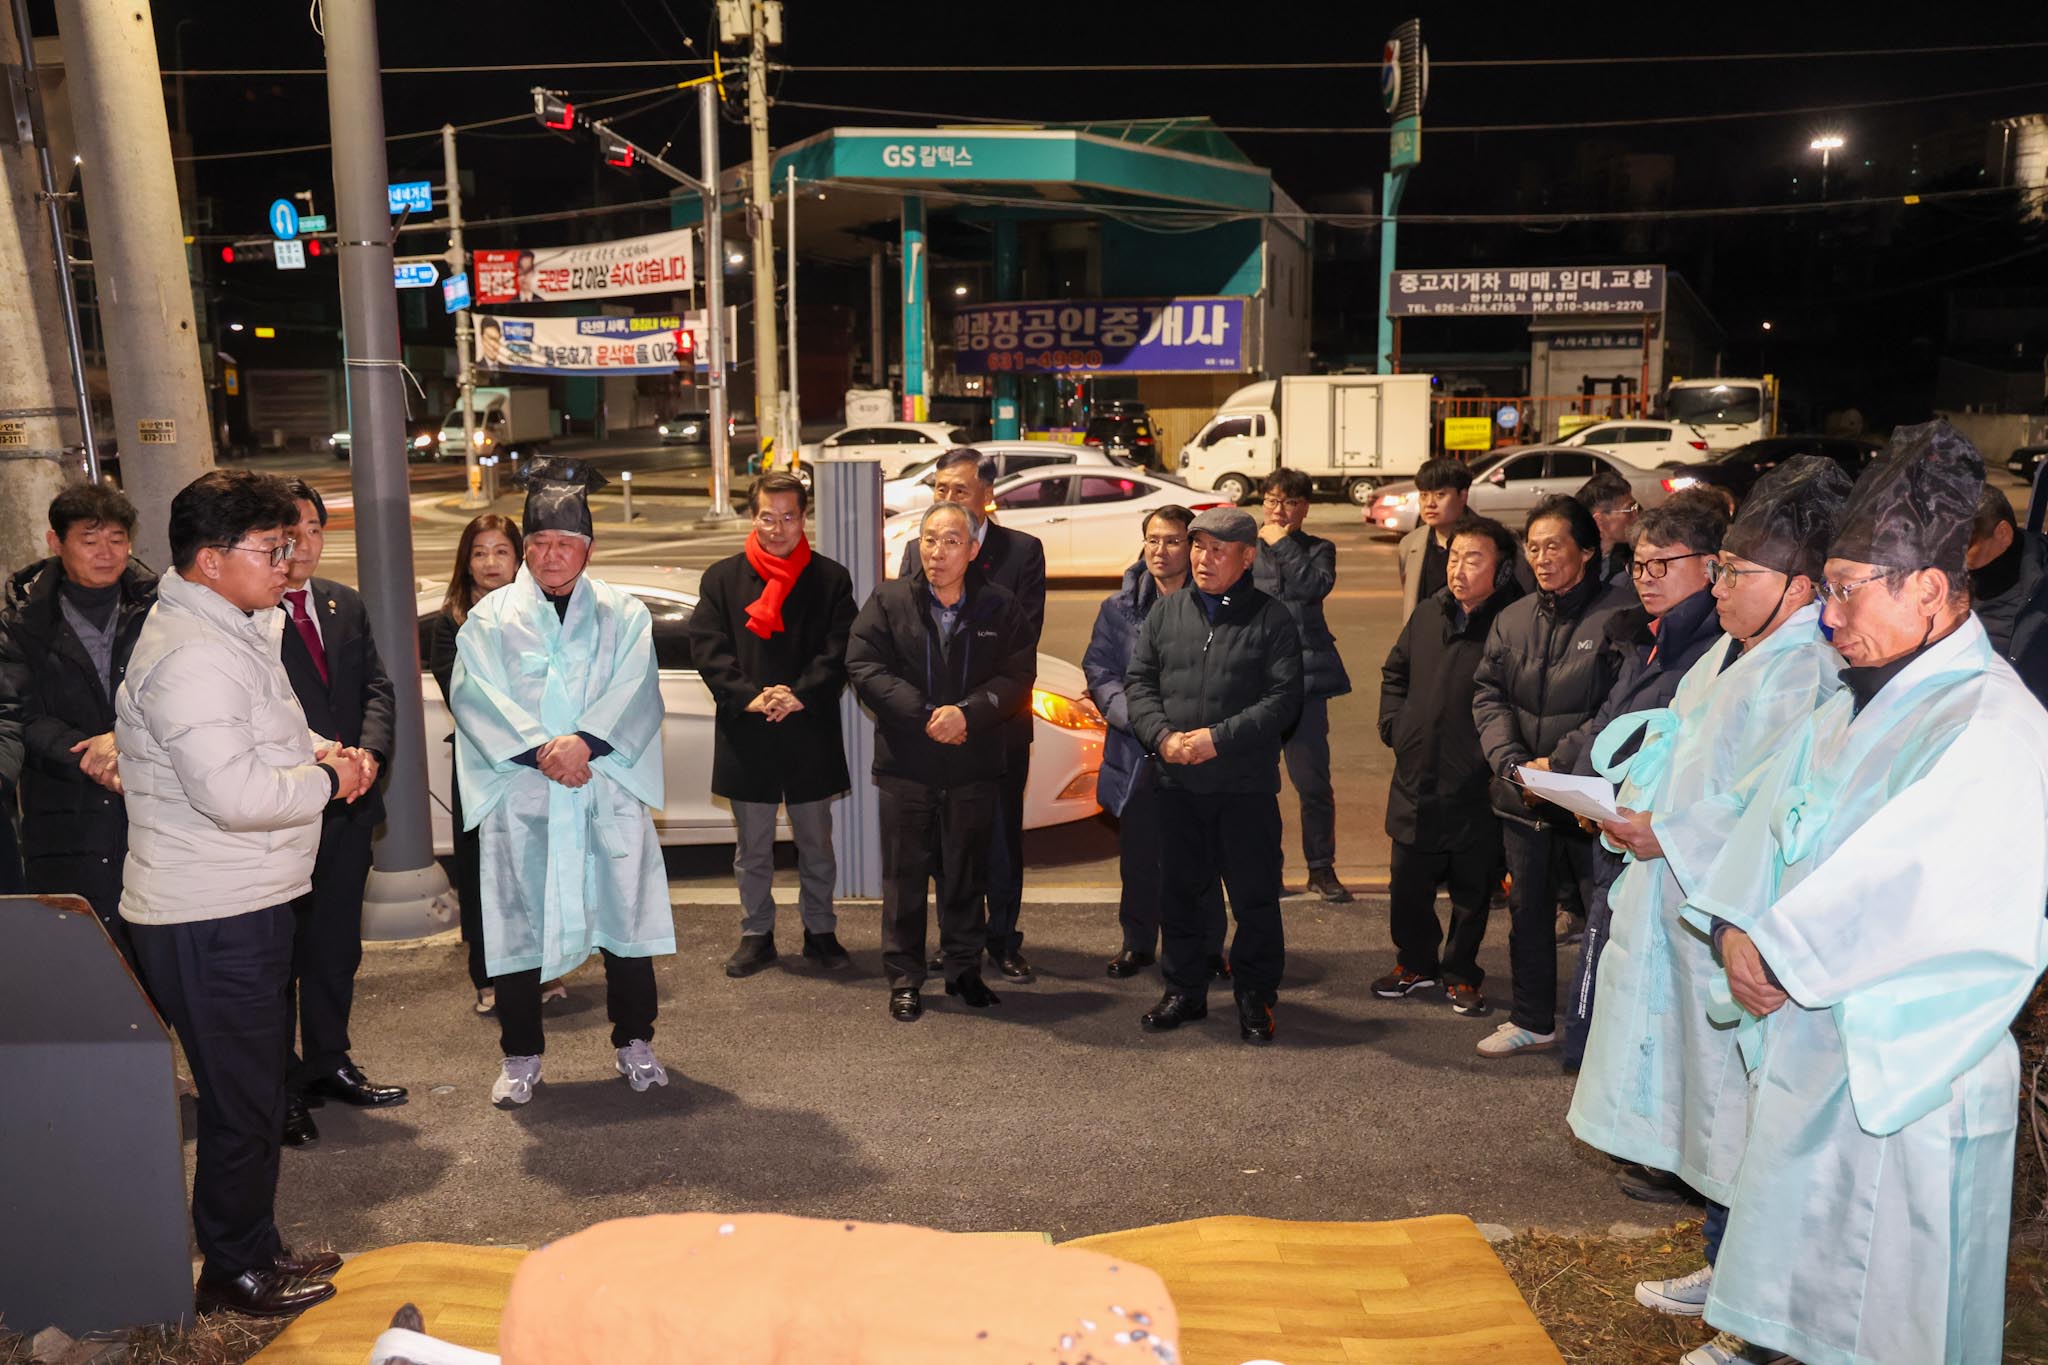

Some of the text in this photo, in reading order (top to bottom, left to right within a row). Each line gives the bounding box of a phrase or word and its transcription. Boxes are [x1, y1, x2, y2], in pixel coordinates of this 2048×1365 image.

[882, 145, 973, 168] GS 칼텍스
[537, 256, 686, 292] 국민은 더 이상 속지 않습니다
[1399, 269, 1653, 293] 중고지게차 매매.임대.교환
[1408, 304, 1432, 313] TEL.
[956, 304, 1230, 351] 일광장공인중개사
[987, 351, 1103, 370] 631-4980
